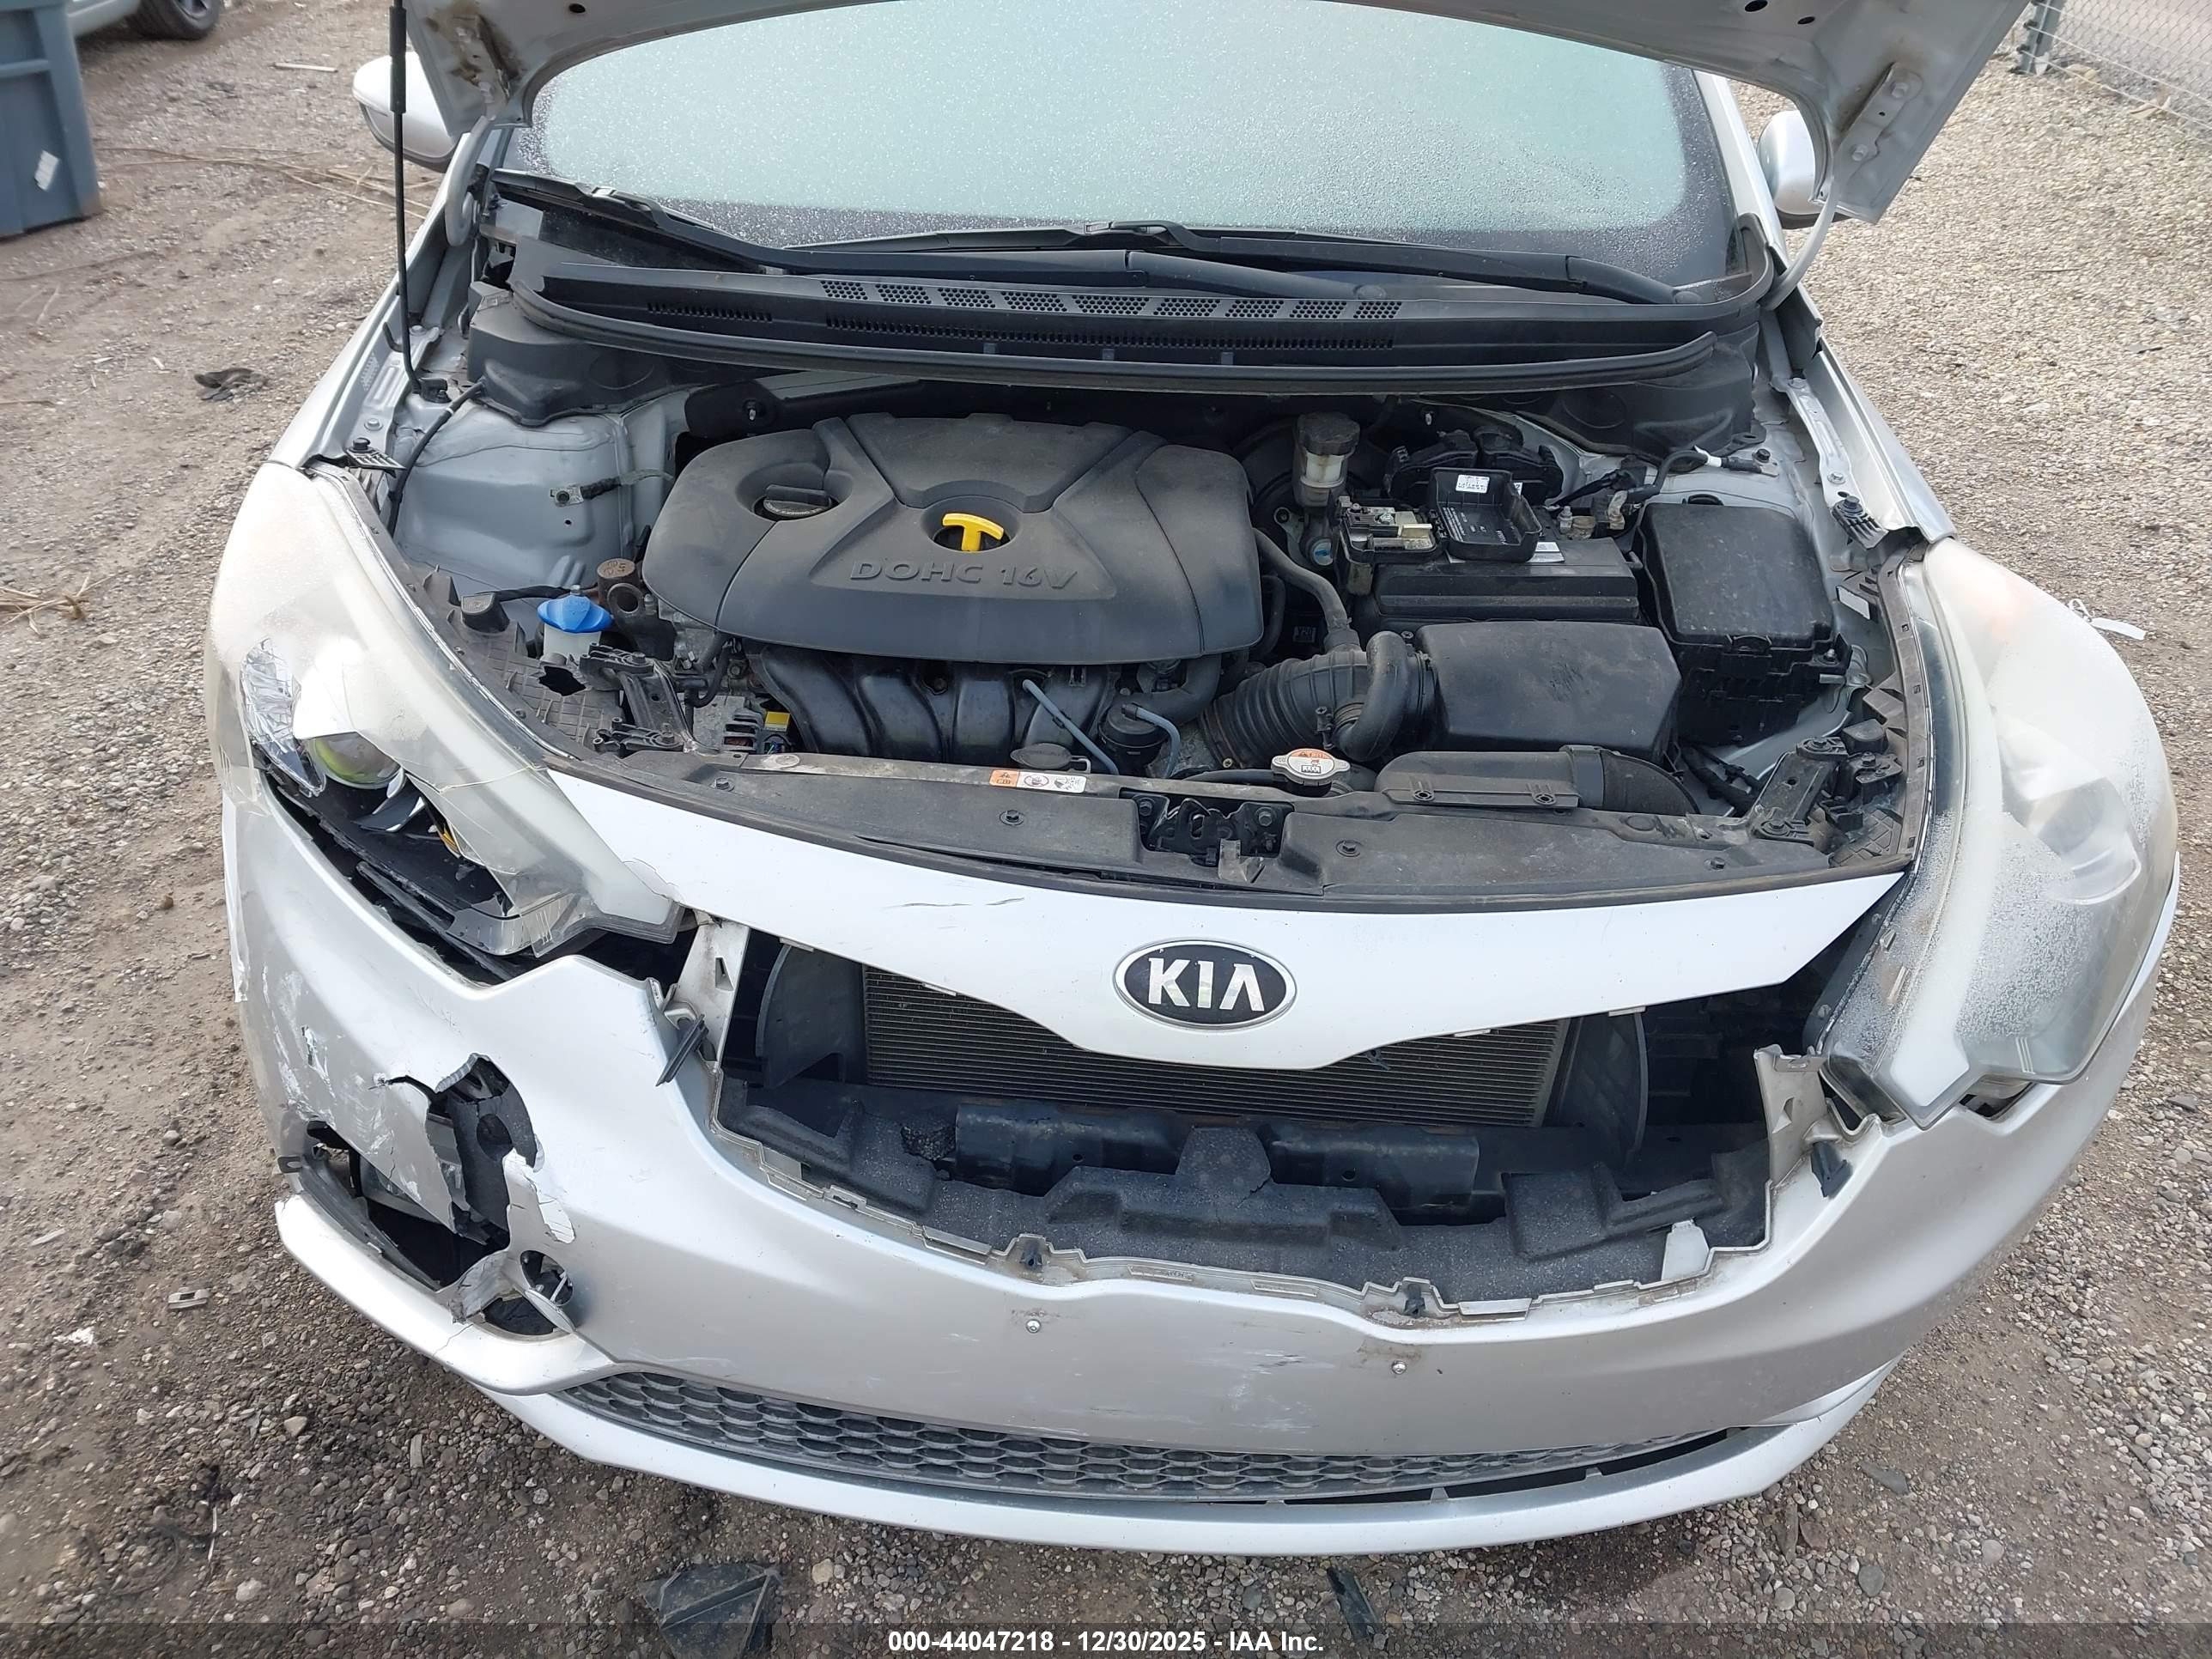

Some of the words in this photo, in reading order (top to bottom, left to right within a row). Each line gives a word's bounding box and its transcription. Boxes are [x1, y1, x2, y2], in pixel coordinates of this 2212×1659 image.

[849, 562, 983, 584] DOHC
[1000, 563, 1079, 590] 16V
[1148, 957, 1265, 1012] KIA
